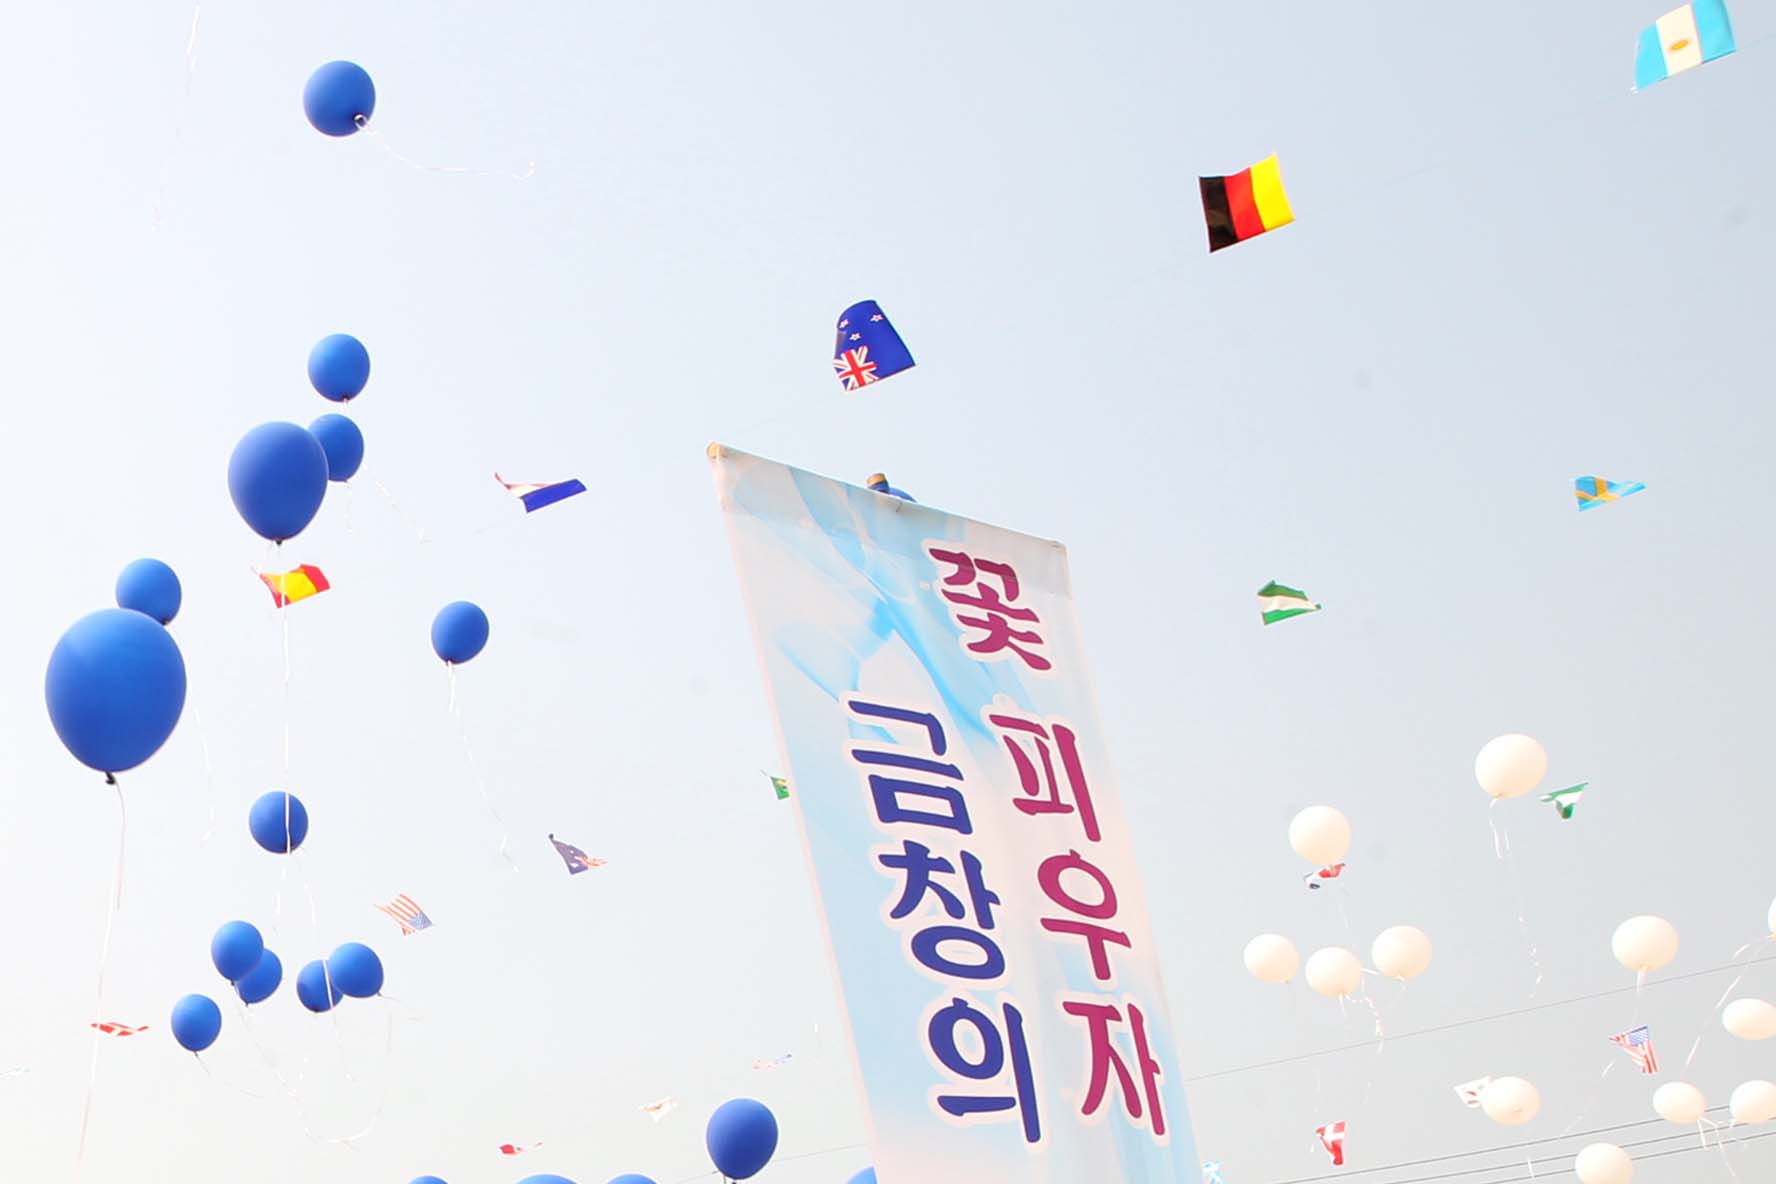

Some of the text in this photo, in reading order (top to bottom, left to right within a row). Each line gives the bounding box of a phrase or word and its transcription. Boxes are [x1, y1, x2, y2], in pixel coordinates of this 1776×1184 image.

[848, 700, 1041, 1143] 금창의
[928, 547, 1166, 1136] 꽃 피우자
